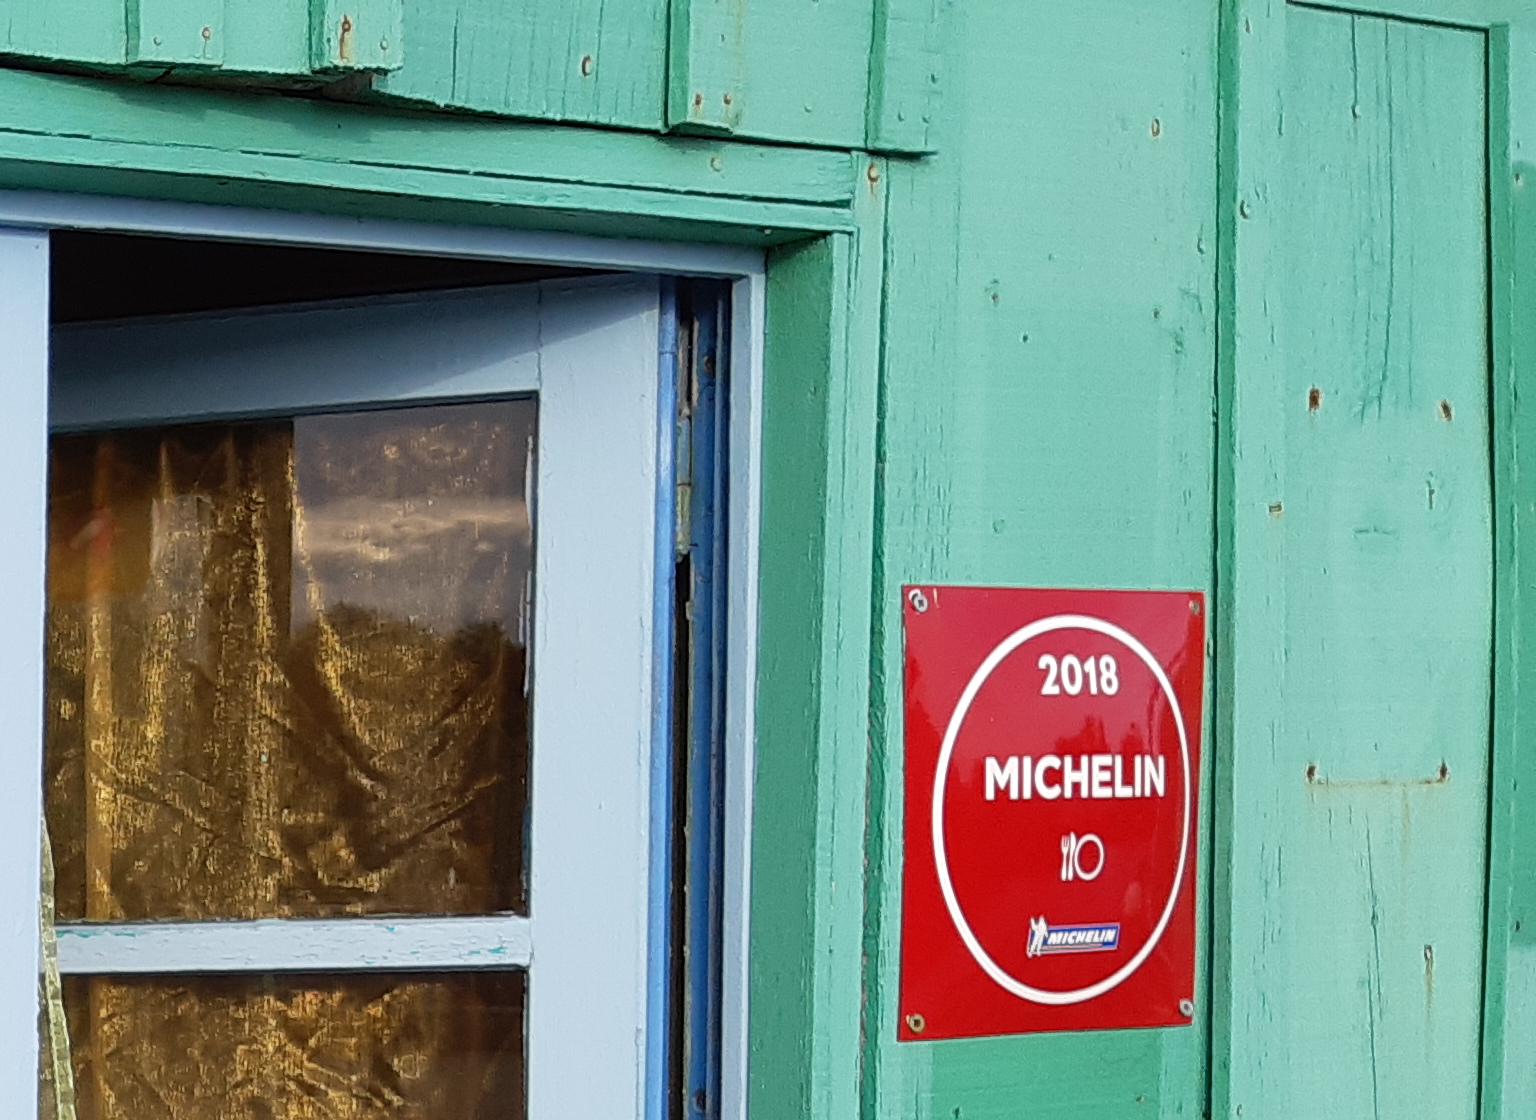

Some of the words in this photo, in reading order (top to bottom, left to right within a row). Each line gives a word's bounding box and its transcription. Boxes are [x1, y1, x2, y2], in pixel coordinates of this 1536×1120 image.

[1038, 654, 1119, 695] 2018
[985, 754, 1165, 801] MICHELIN
[1047, 929, 1117, 945] MICHELIN
